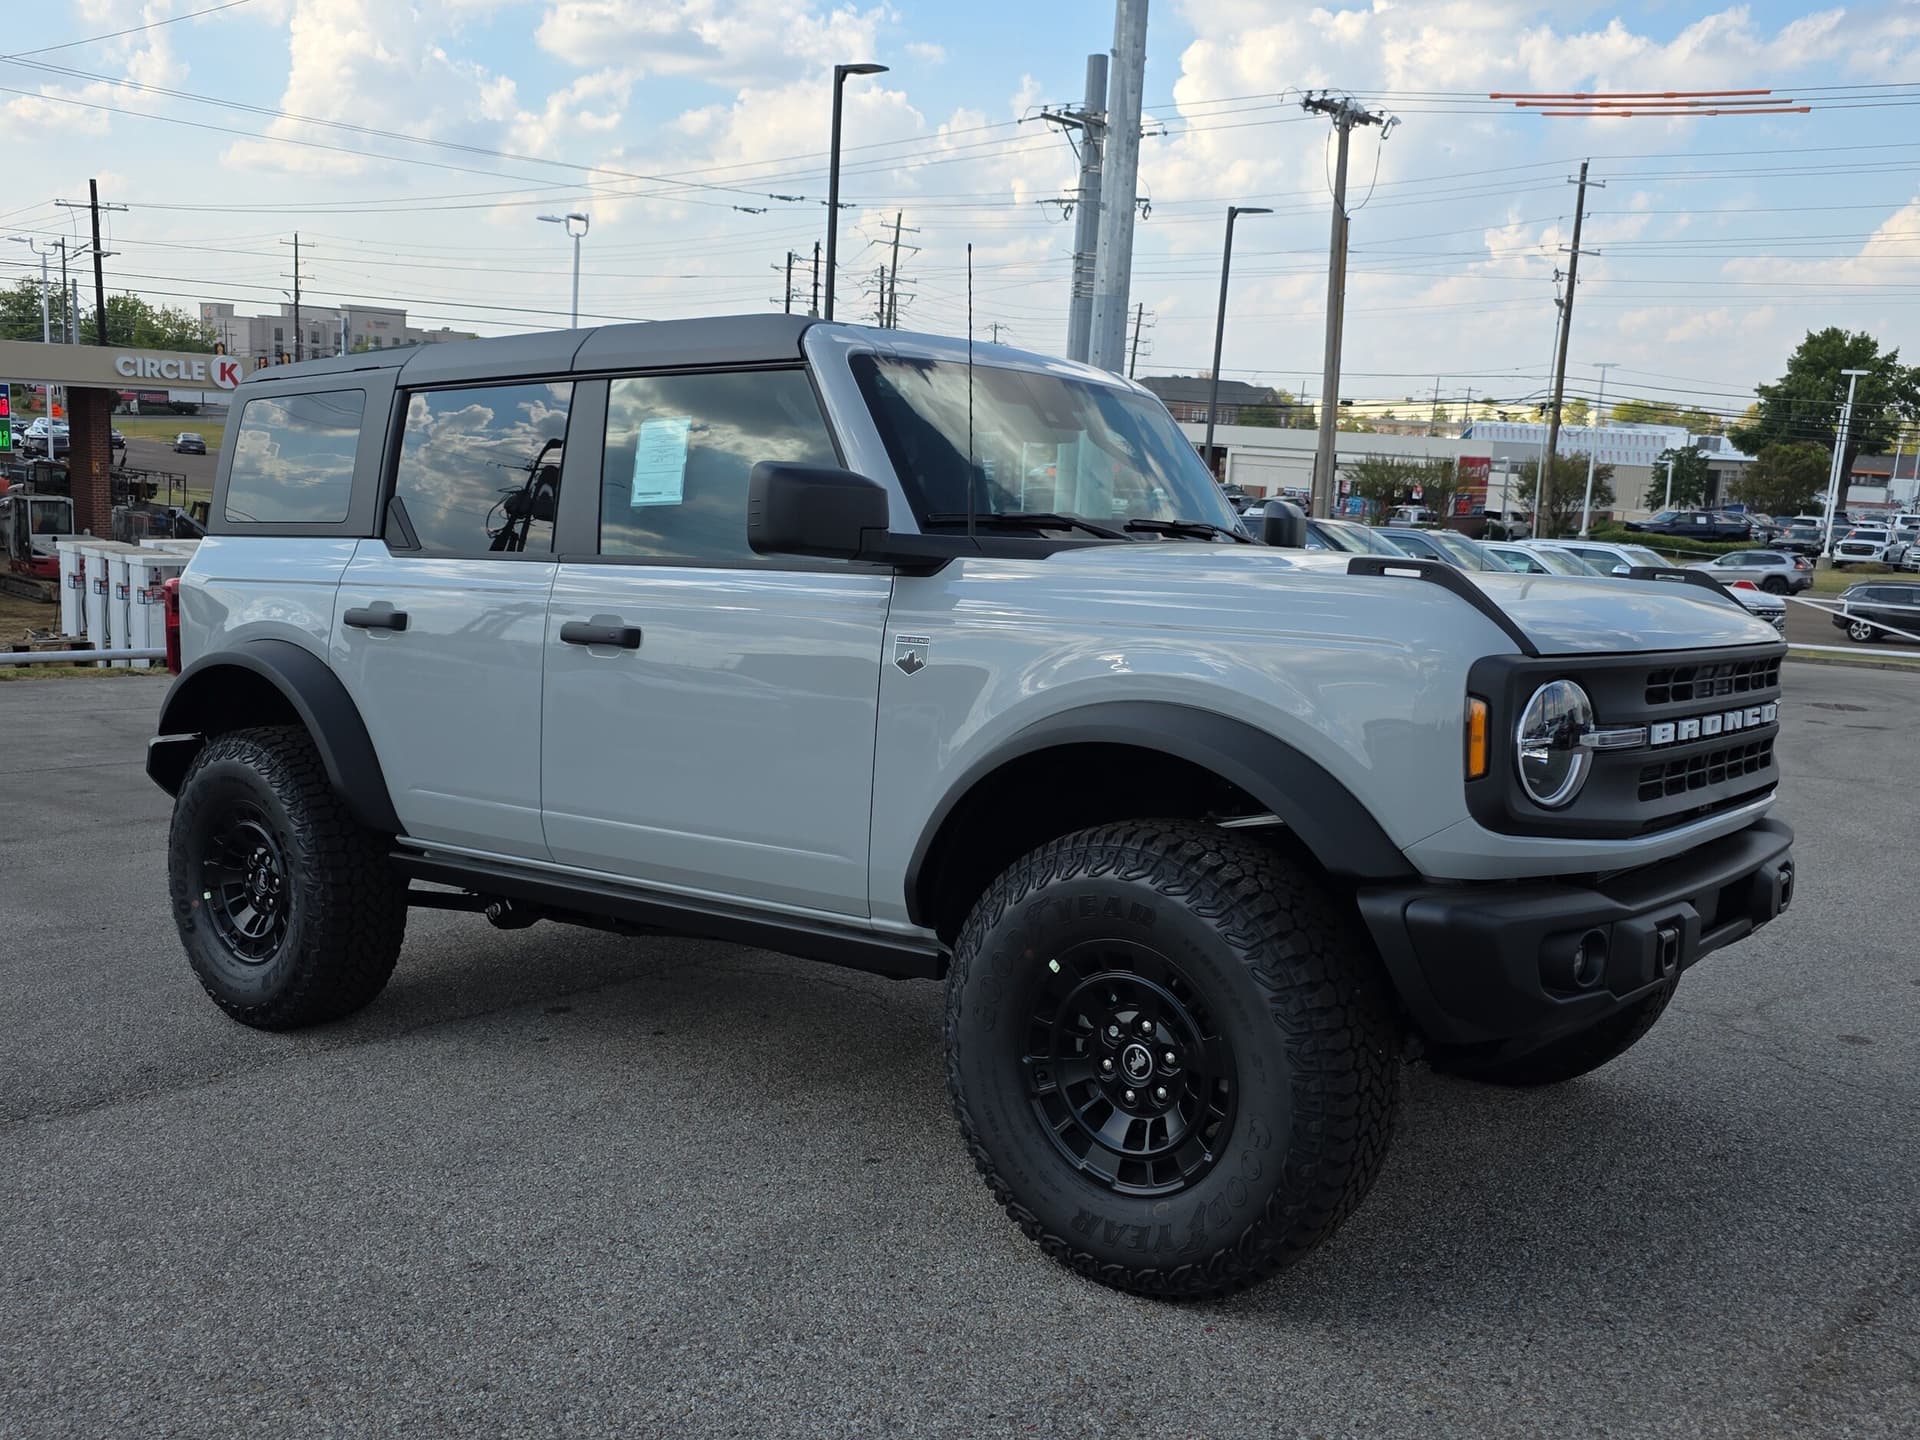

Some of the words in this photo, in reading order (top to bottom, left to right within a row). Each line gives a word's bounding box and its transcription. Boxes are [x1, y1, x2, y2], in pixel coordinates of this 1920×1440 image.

[115, 355, 205, 381] CIRCLE
[219, 362, 240, 387] K
[1650, 703, 1777, 744] BRONCO
